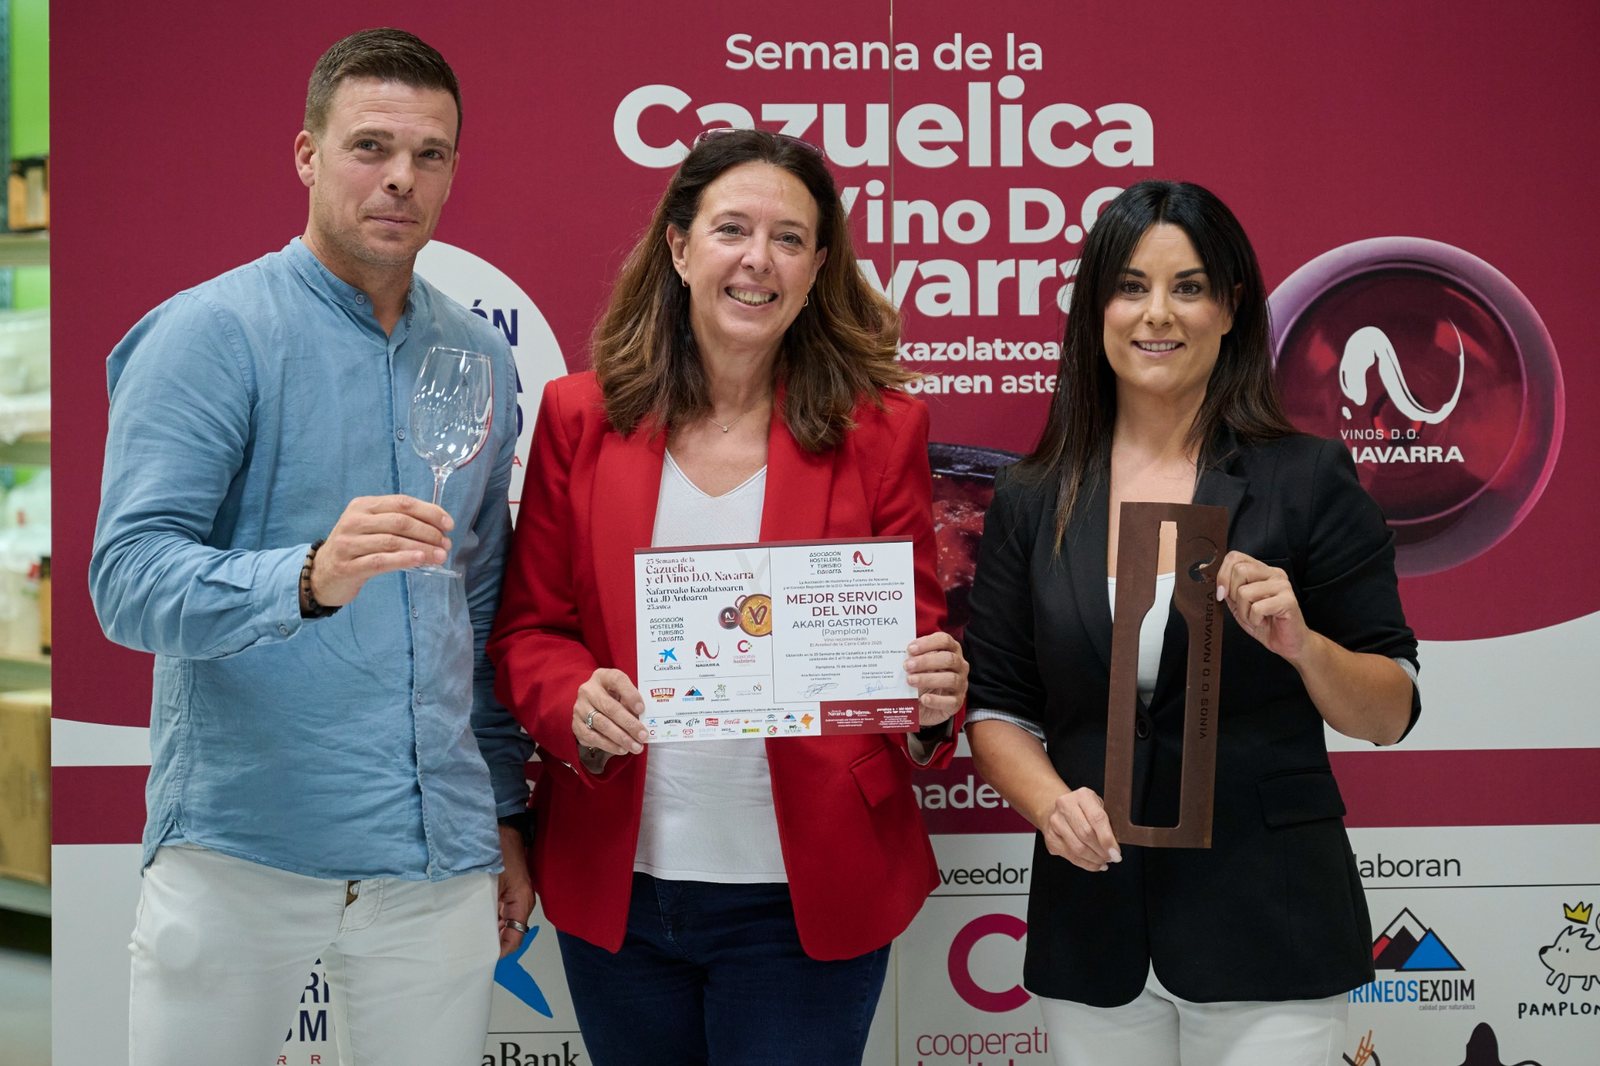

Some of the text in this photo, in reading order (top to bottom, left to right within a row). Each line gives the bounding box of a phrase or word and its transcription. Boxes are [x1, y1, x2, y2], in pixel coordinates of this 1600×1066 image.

[725, 32, 1043, 71] Semana de la
[894, 336, 1064, 361] kazolatxoa
[1340, 428, 1420, 440] VINOS D.O.
[646, 563, 695, 574] Cazuelica
[646, 571, 754, 587] y el Vino D.O. Navarra
[674, 594, 708, 602] Ardoaren
[786, 590, 903, 605] MEJOR SERVICIO
[812, 604, 878, 617] DEL VINO
[792, 617, 898, 629] AKARI GASTROTEKA
[1204, 591, 1214, 663] NAVARRA
[821, 628, 869, 637] (Pamplona)
[1200, 698, 1209, 740] VINOS
[939, 863, 1028, 885] veedor
[916, 1026, 1048, 1064] cooperati
